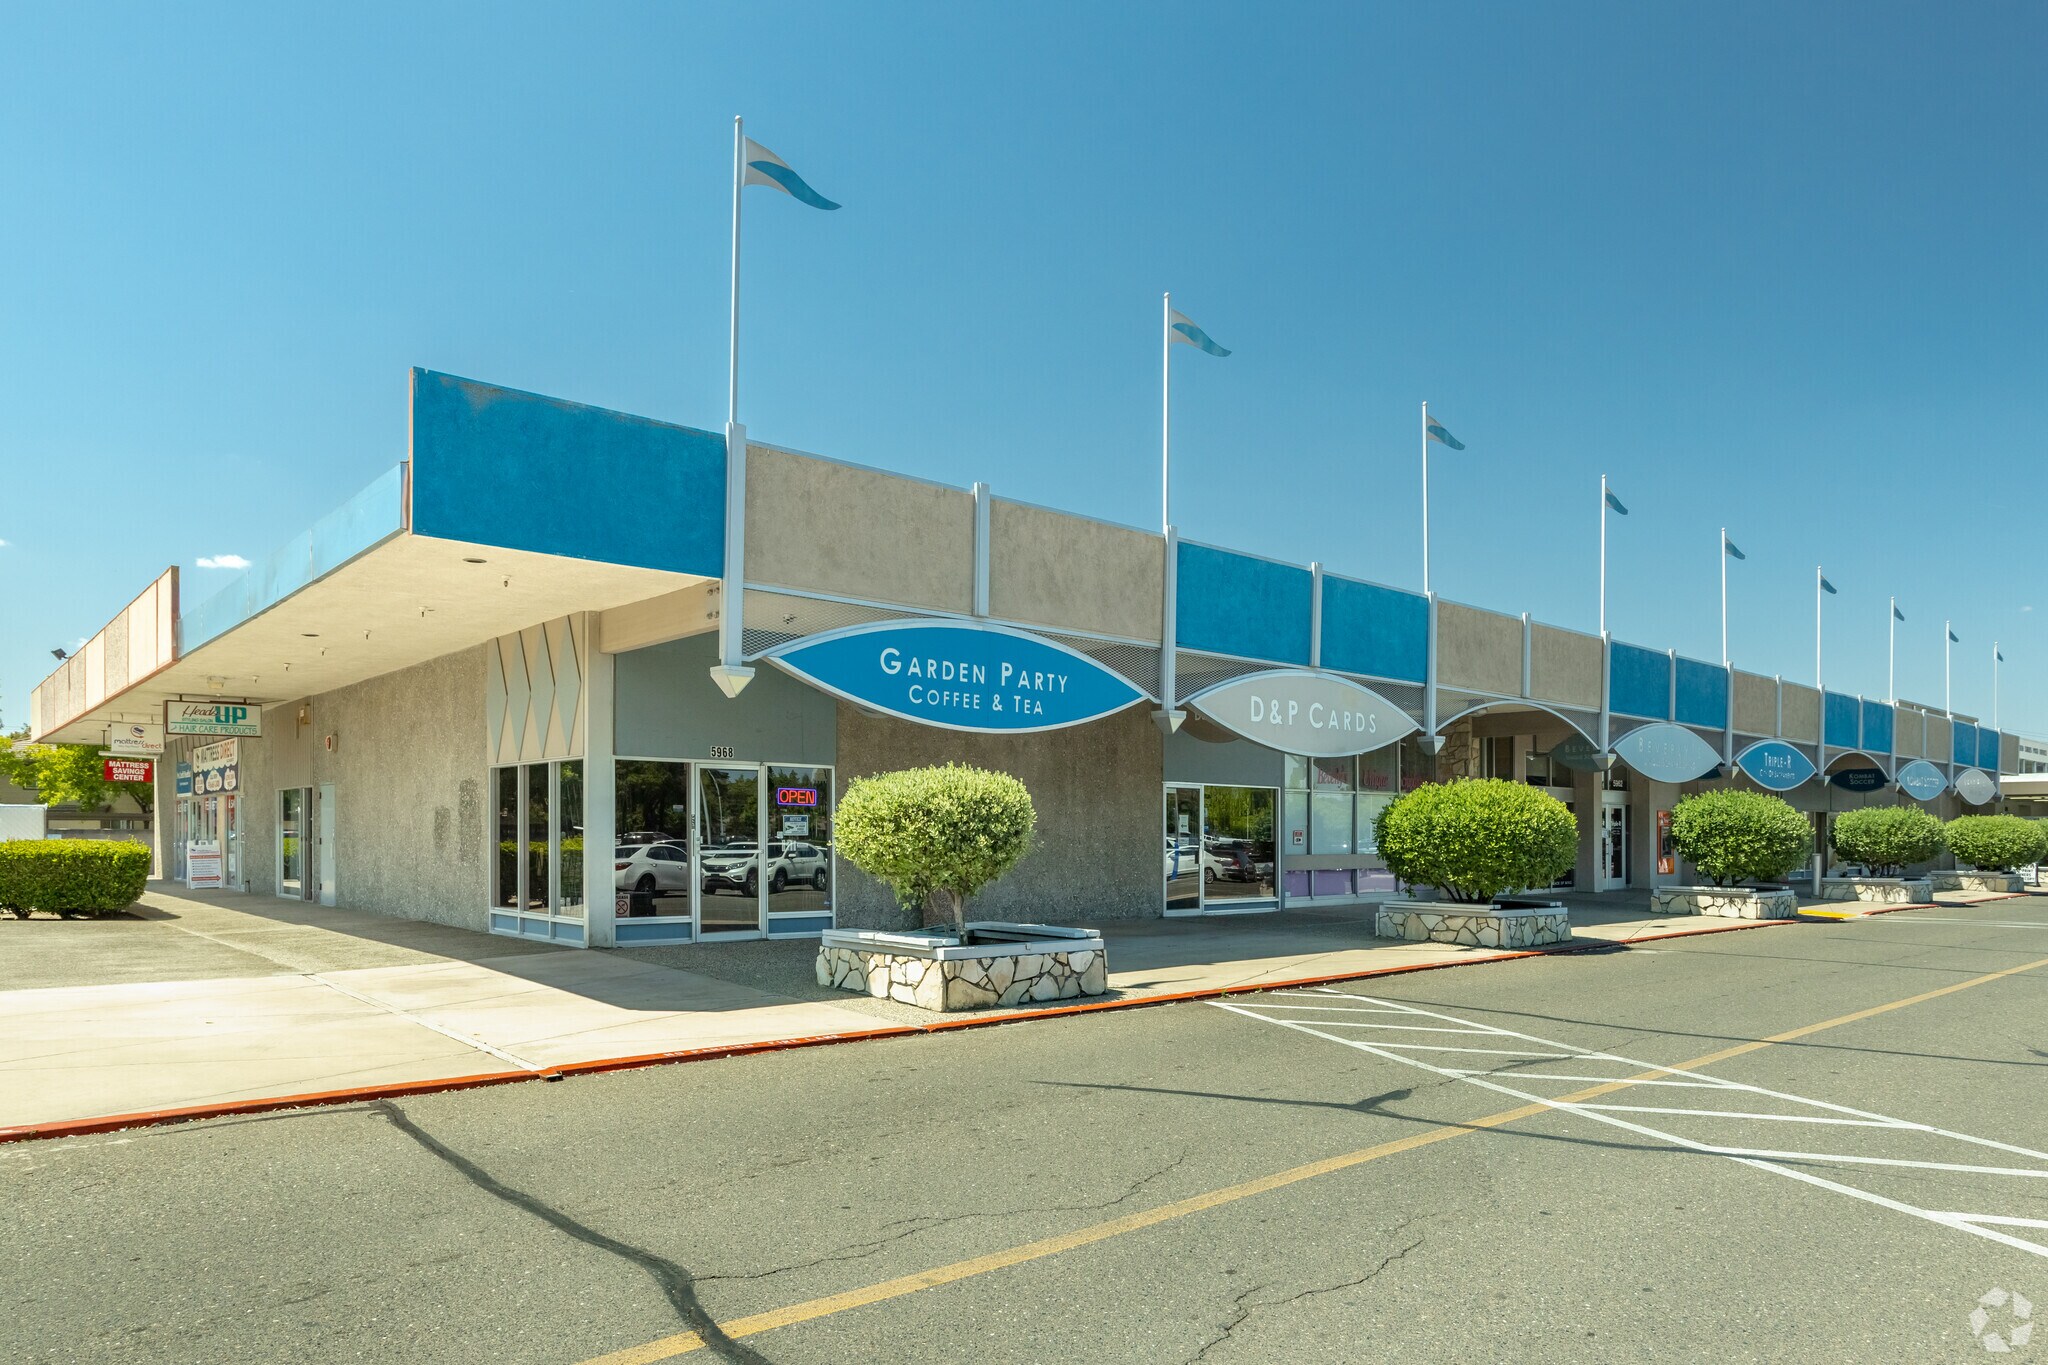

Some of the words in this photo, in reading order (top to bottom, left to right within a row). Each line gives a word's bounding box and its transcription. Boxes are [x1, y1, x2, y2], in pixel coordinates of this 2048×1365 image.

[880, 647, 985, 685] GARDEN
[1001, 662, 1068, 693] PARTY
[908, 684, 980, 710] COFFEE
[992, 693, 1003, 712] &
[1013, 695, 1043, 715] TEA
[182, 705, 218, 717] Heads
[214, 705, 247, 724] UP
[1250, 695, 1299, 726] D&P
[1309, 702, 1377, 734] CARDS
[199, 725, 219, 733] CARE
[220, 726, 258, 735] PRODUCTS
[711, 746, 734, 758] 5968
[108, 760, 150, 769] MATTRESS
[1764, 752, 1792, 769] TRIPLE-R
[112, 767, 145, 775] SAVINGS
[113, 774, 144, 782] CENTER
[779, 789, 815, 804] OPEN
